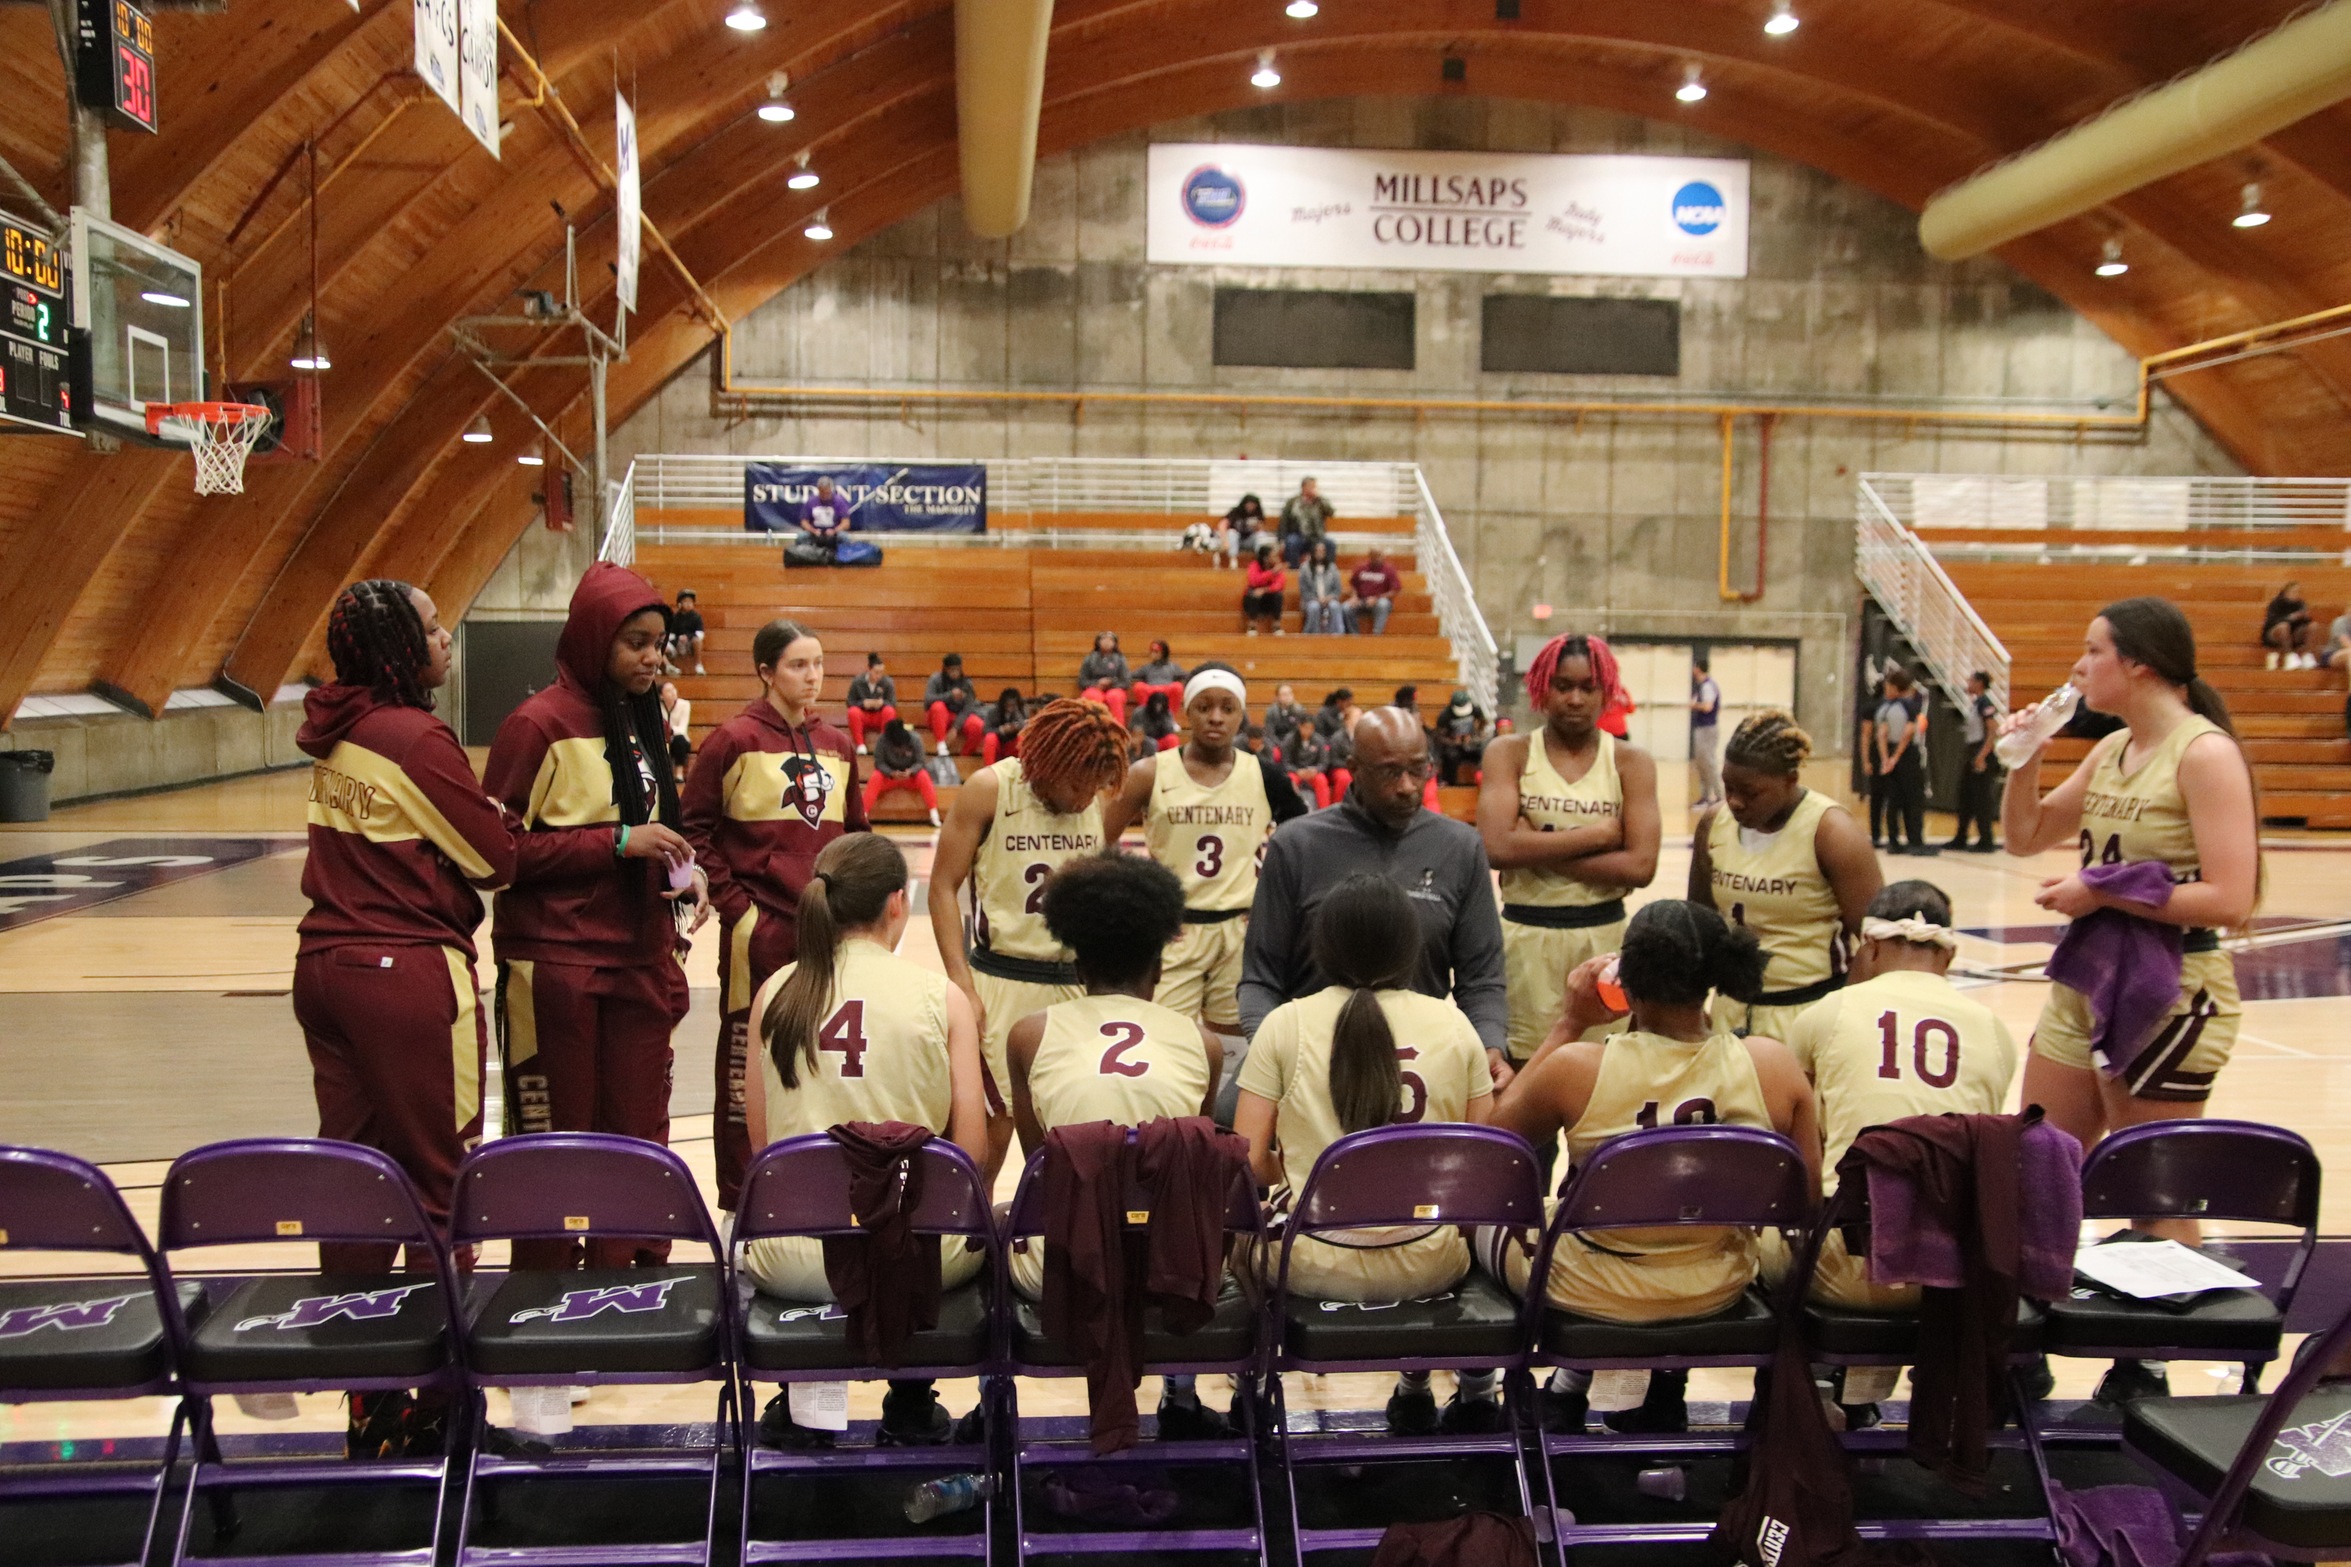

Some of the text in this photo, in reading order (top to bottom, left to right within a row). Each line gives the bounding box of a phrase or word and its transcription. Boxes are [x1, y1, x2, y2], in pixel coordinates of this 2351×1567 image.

[120, 46, 151, 122] 30
[1374, 173, 1528, 208] MILLSAPS
[1374, 214, 1527, 249] COLLEGE
[37, 303, 50, 341] 2
[9, 340, 59, 371] PLAYER FOULS
[875, 484, 982, 505] SECTION
[1166, 806, 1255, 826] CENTENARY
[1006, 835, 1098, 851] CENTENARY
[1195, 834, 1224, 878] 3
[818, 999, 868, 1078] 4
[1099, 1021, 1150, 1078] 2
[1876, 1009, 1960, 1090] 10
